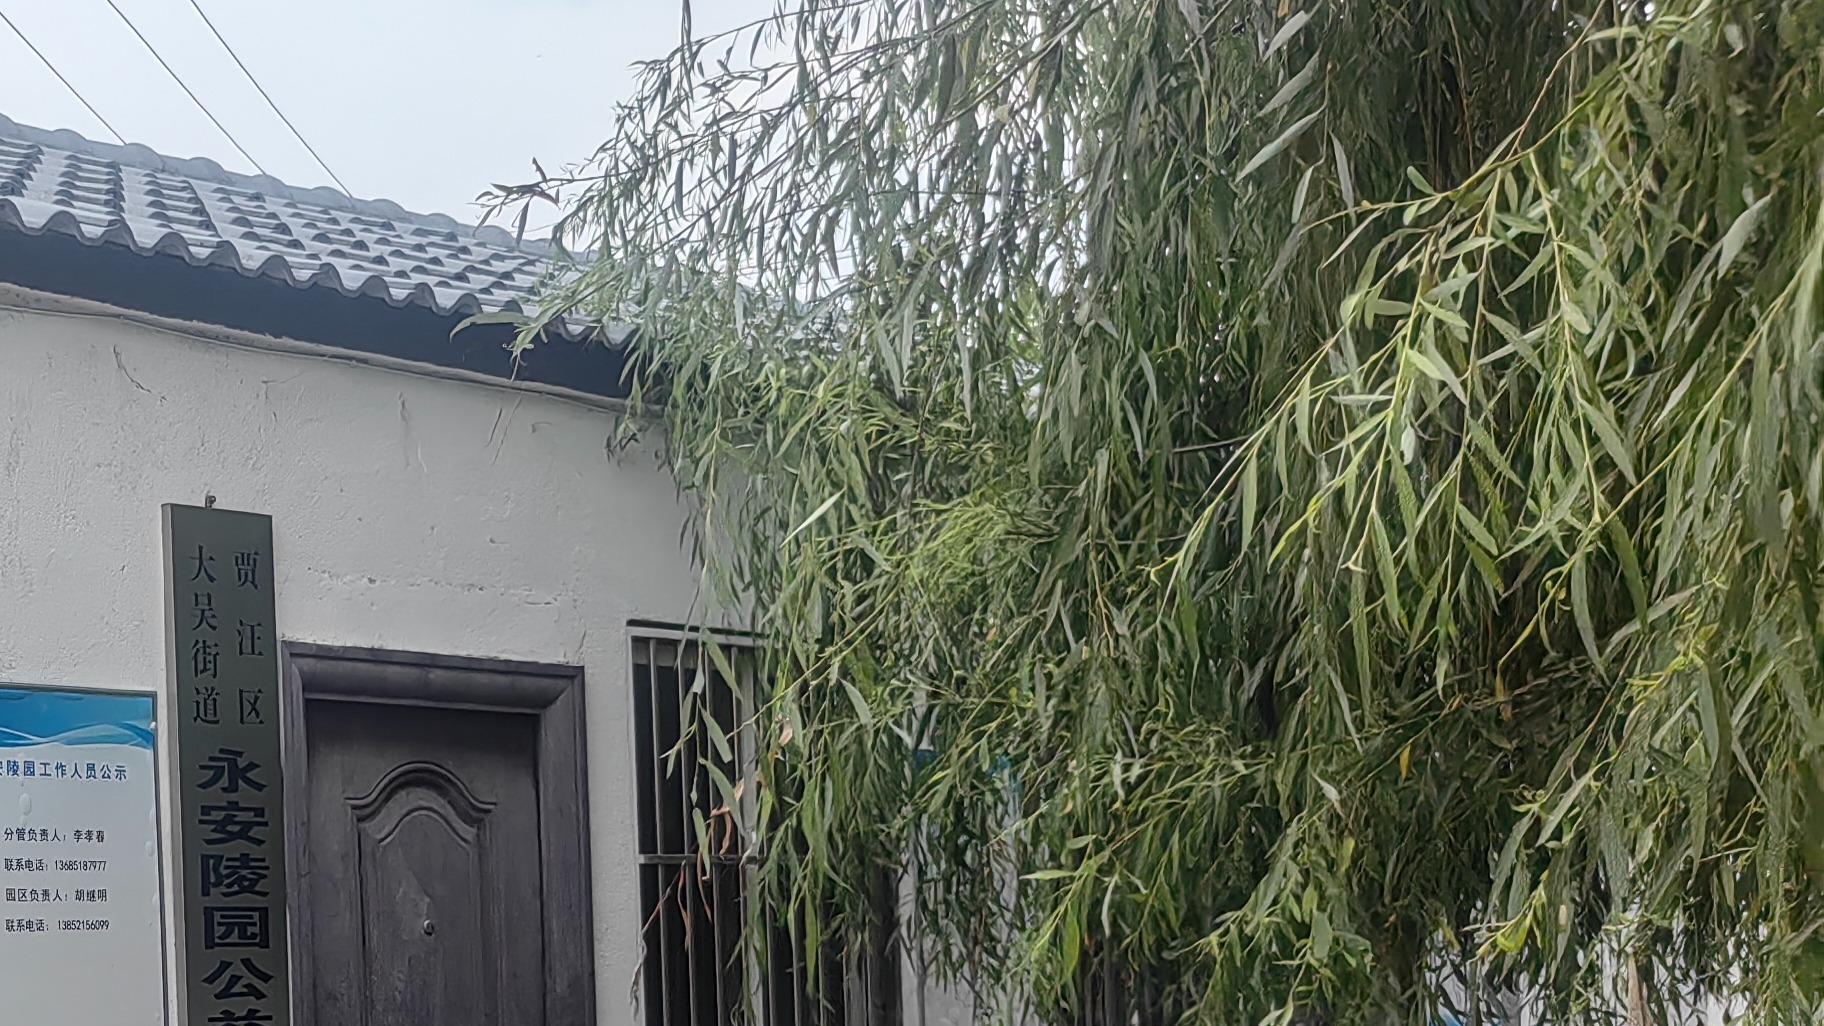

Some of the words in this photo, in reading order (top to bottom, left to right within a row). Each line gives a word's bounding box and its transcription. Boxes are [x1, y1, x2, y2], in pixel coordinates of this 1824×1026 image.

[189, 544, 222, 729] 大吴街道
[234, 549, 266, 727] 贾汪区
[4, 858, 107, 872] 联系电话：13685187977
[5, 888, 108, 903] 园区负责人：胡继明
[5, 918, 110, 933] 联系电话：13852156099
